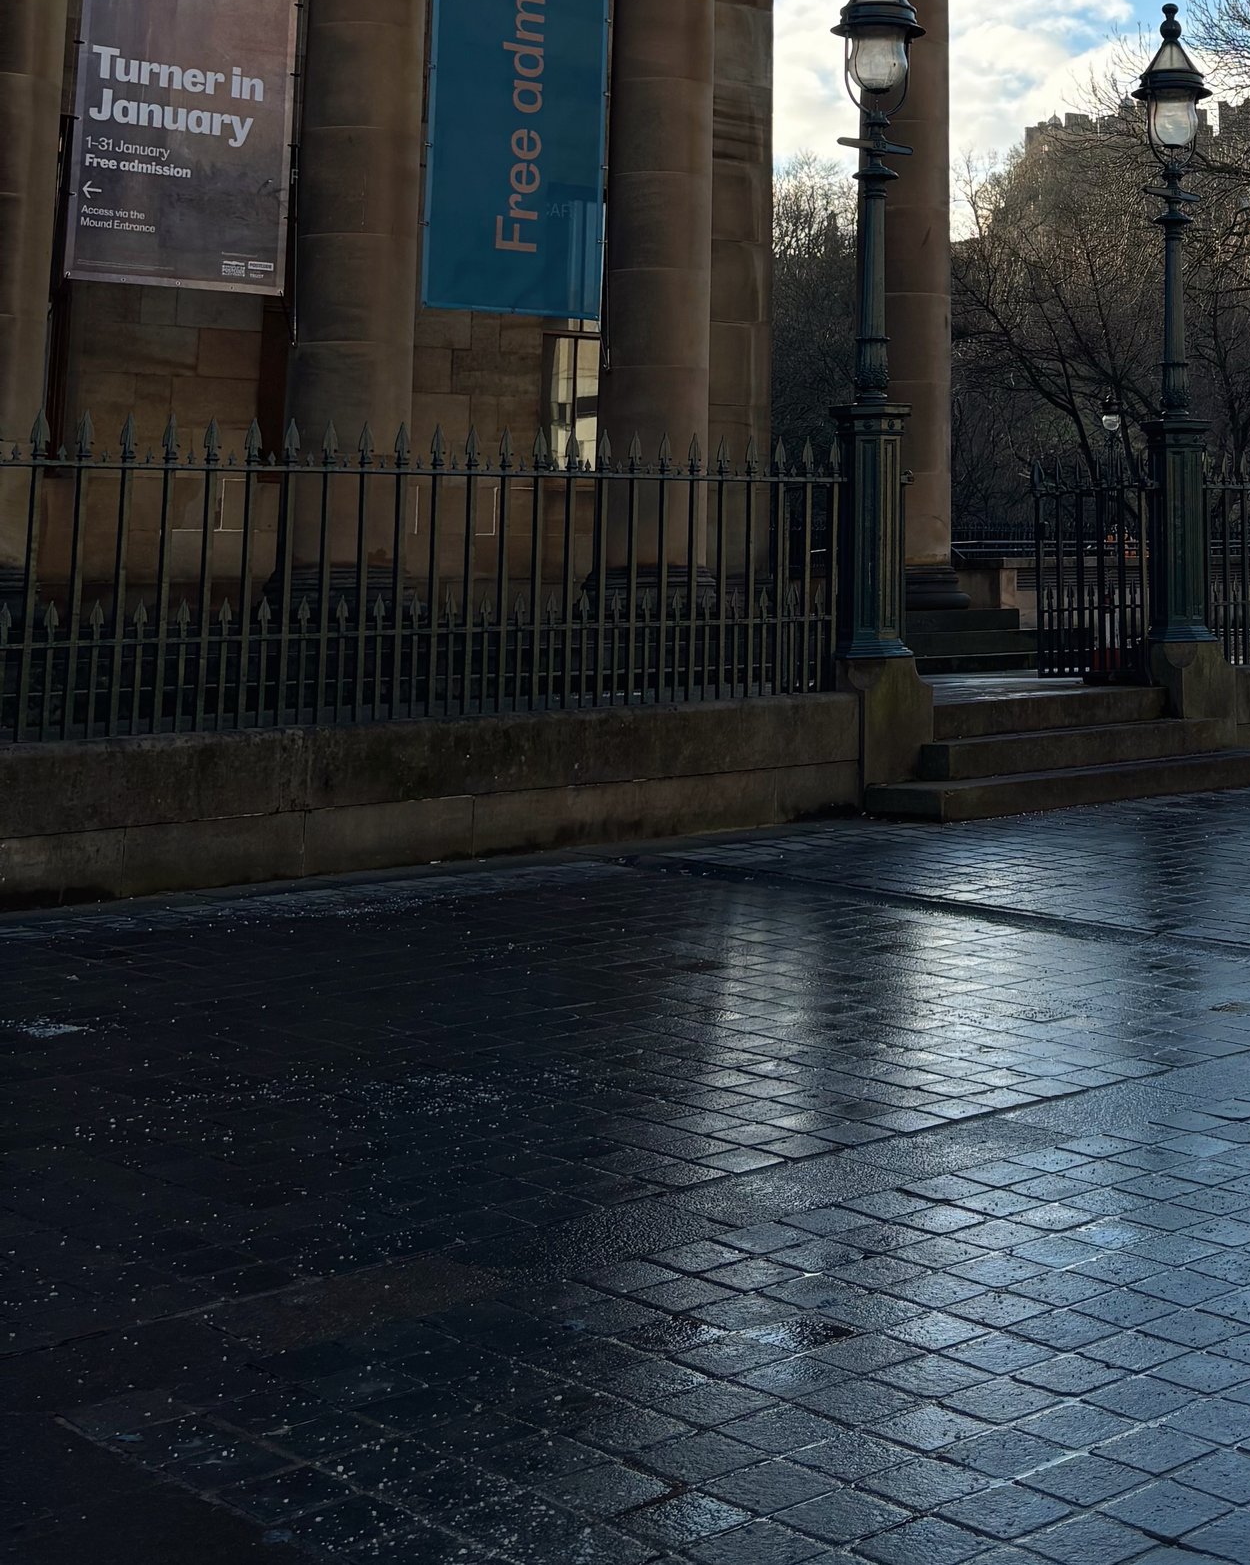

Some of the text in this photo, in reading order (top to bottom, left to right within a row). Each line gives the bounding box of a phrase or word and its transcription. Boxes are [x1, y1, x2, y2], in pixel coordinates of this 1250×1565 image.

[92, 44, 264, 102] Turner in
[89, 88, 254, 148] January
[115, 140, 170, 161] January
[85, 154, 191, 178] Free admission
[495, 128, 542, 253] Free
[81, 204, 146, 220] Access via the
[80, 216, 156, 233] Mound Entrance
